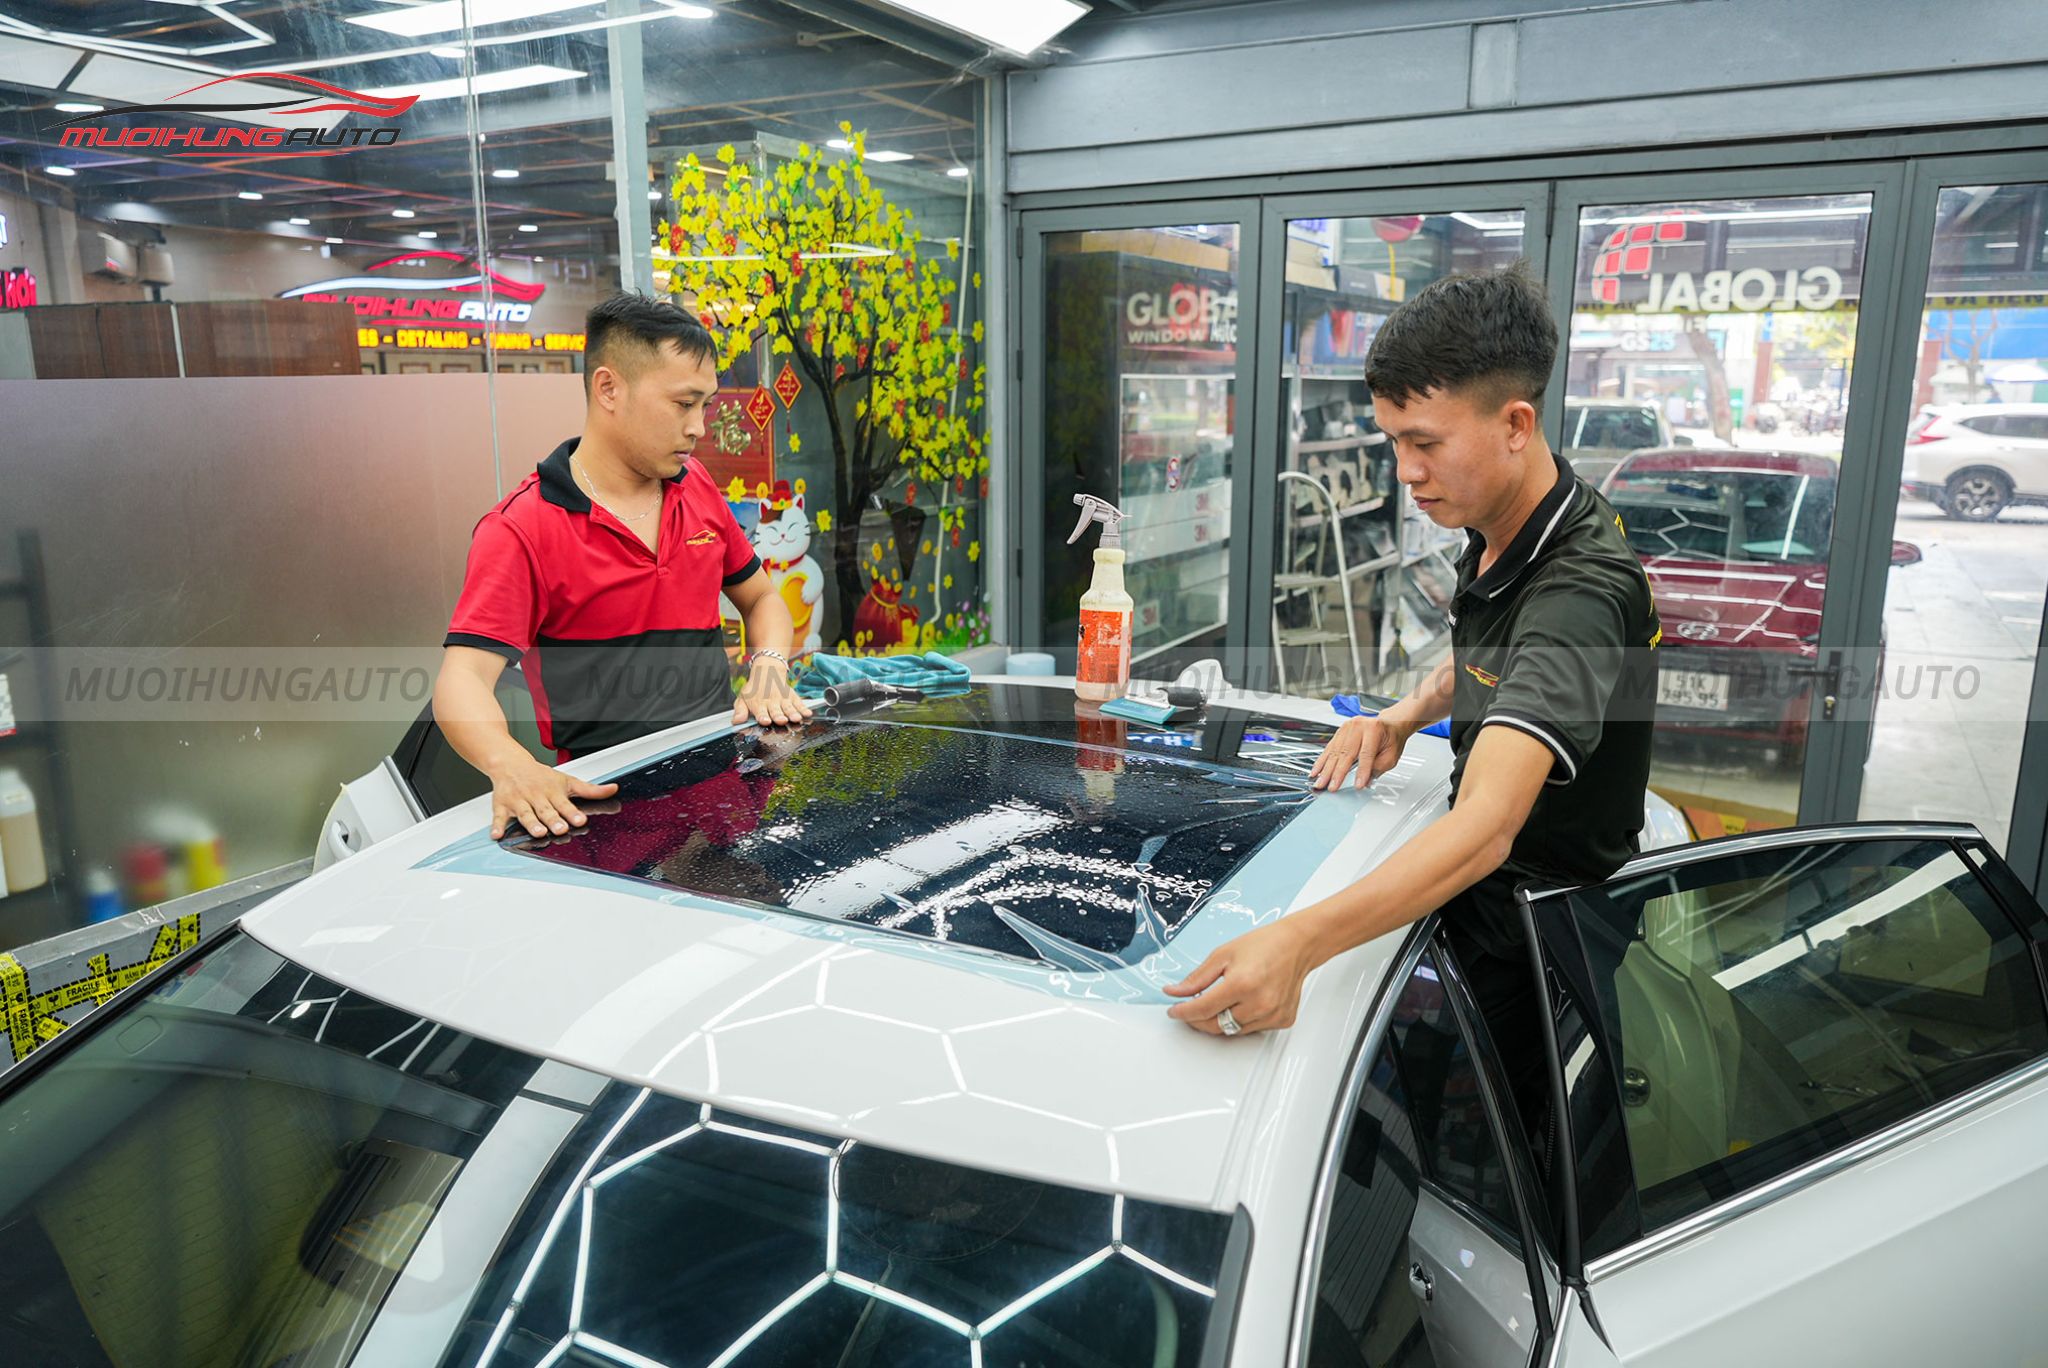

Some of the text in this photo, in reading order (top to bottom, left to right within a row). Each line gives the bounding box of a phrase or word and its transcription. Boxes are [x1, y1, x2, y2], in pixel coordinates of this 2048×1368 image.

[1620, 332, 1676, 351] GS25
[66, 980, 101, 997] FRAGILE
[18, 1009, 30, 1040] FRAGILE
